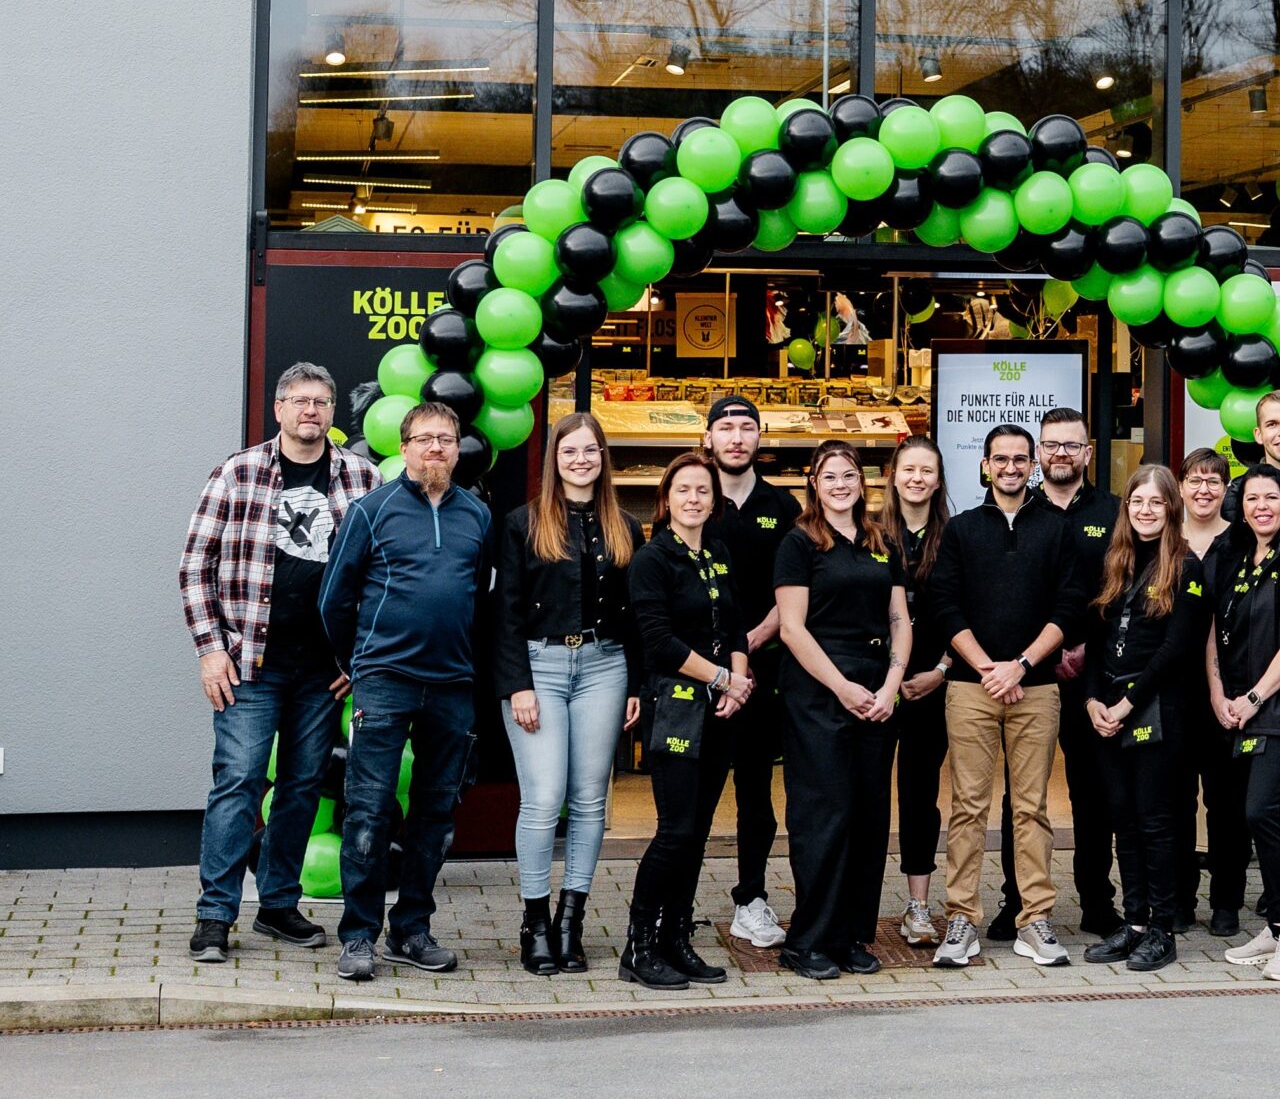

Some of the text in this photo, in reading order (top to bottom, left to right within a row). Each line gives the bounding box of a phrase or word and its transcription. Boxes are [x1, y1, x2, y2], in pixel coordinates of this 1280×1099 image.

[353, 287, 445, 315] KÖLLE
[368, 315, 428, 340] ZOO
[993, 360, 1027, 372] KÖLLE
[999, 372, 1021, 381] ZOO
[961, 391, 1058, 408] PUNKTE FÜR ALLE,
[947, 410, 963, 423] DIE
[967, 410, 996, 423] NOCH
[1000, 410, 1031, 423] KEINE
[757, 516, 778, 525] KÖLLE
[1083, 525, 1107, 534] KÖLLE
[1133, 725, 1153, 737] KÖLLE
[666, 736, 690, 748] KÖLLE
[1136, 733, 1150, 742] ZOO
[669, 744, 685, 753] ZOO
